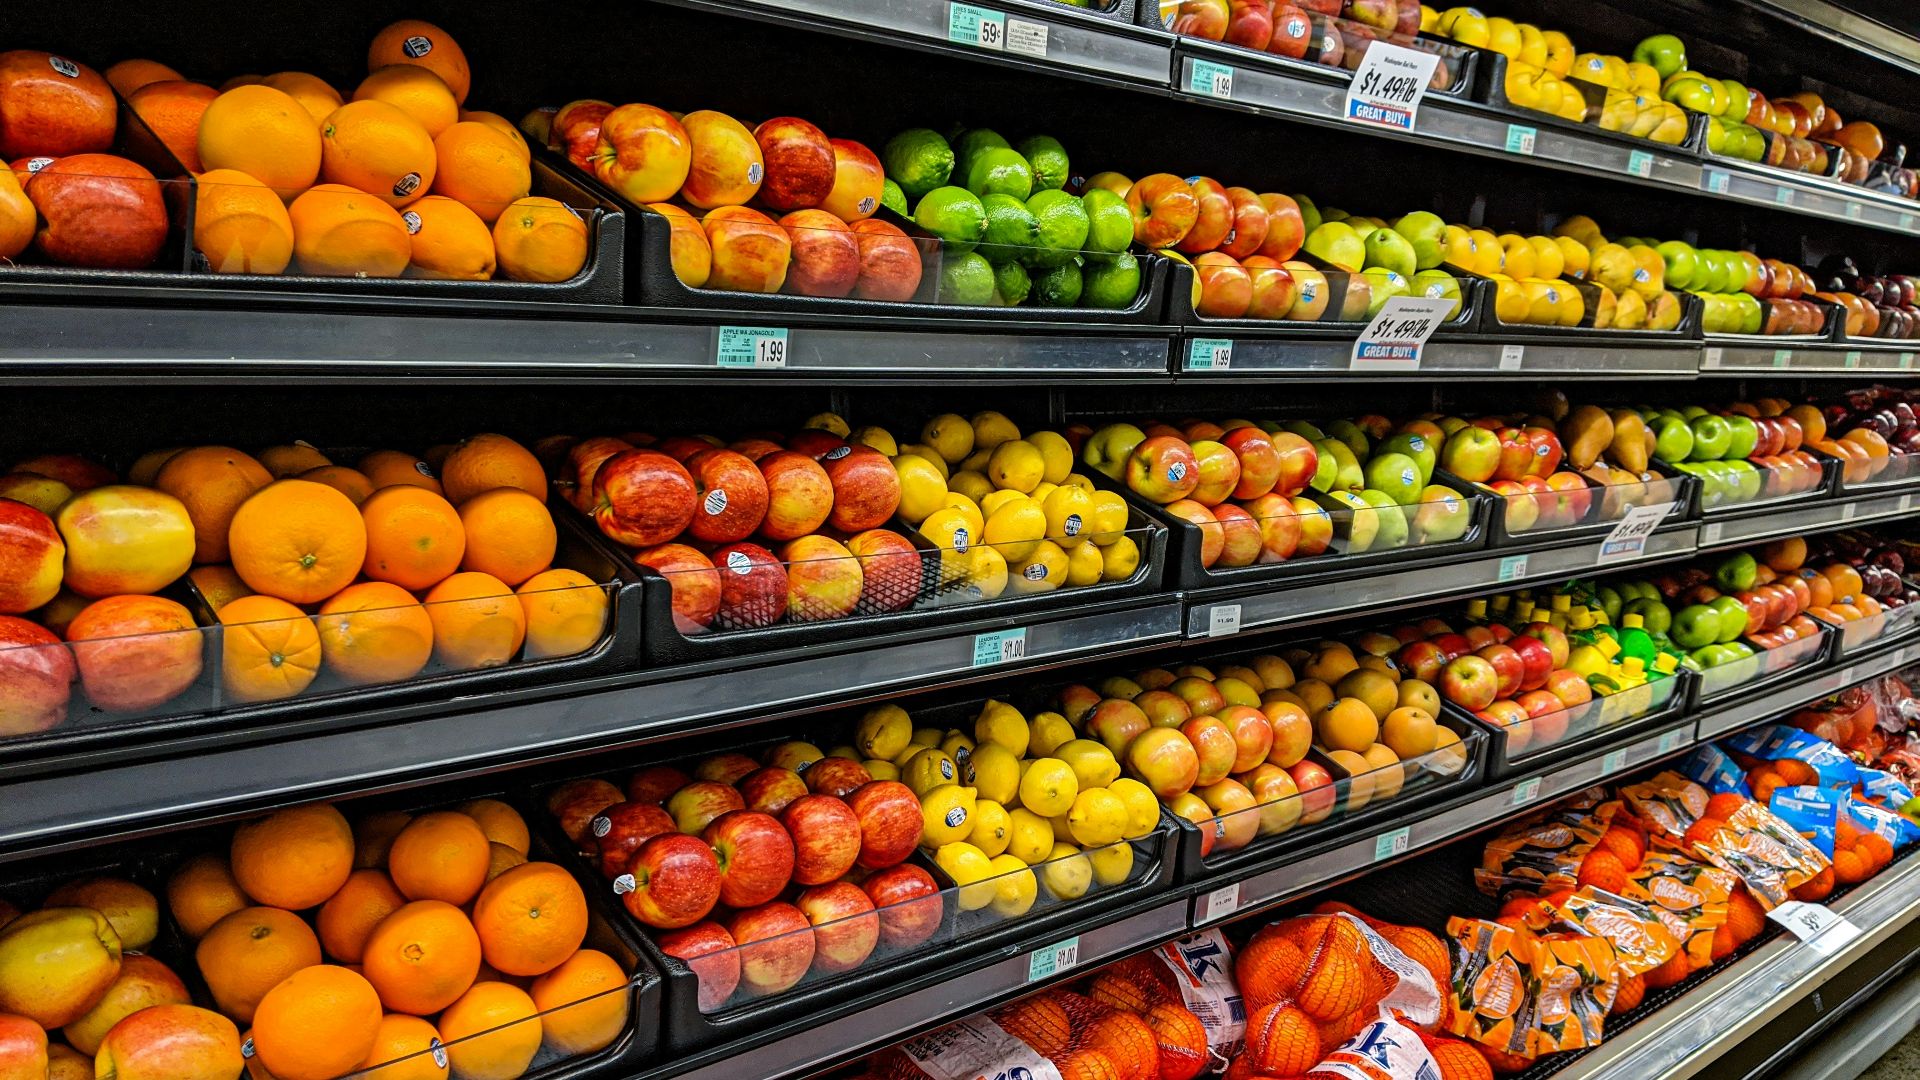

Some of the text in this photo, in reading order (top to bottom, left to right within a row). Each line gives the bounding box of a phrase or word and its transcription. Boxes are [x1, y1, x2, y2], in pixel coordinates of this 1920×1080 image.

[968, 8, 982, 16] SMALL
[1216, 76, 1230, 95] 1.99
[1360, 68, 1404, 99] $1.49
[1402, 77, 1418, 103] lb
[1356, 104, 1384, 120] GREAT
[1384, 110, 1406, 125] BUY!
[1371, 317, 1417, 338] $1.49
[760, 340, 783, 362] 1.99
[1215, 349, 1229, 366] 1.99
[1363, 345, 1413, 358] GREAT BUY!
[978, 635, 994, 643] LEMON
